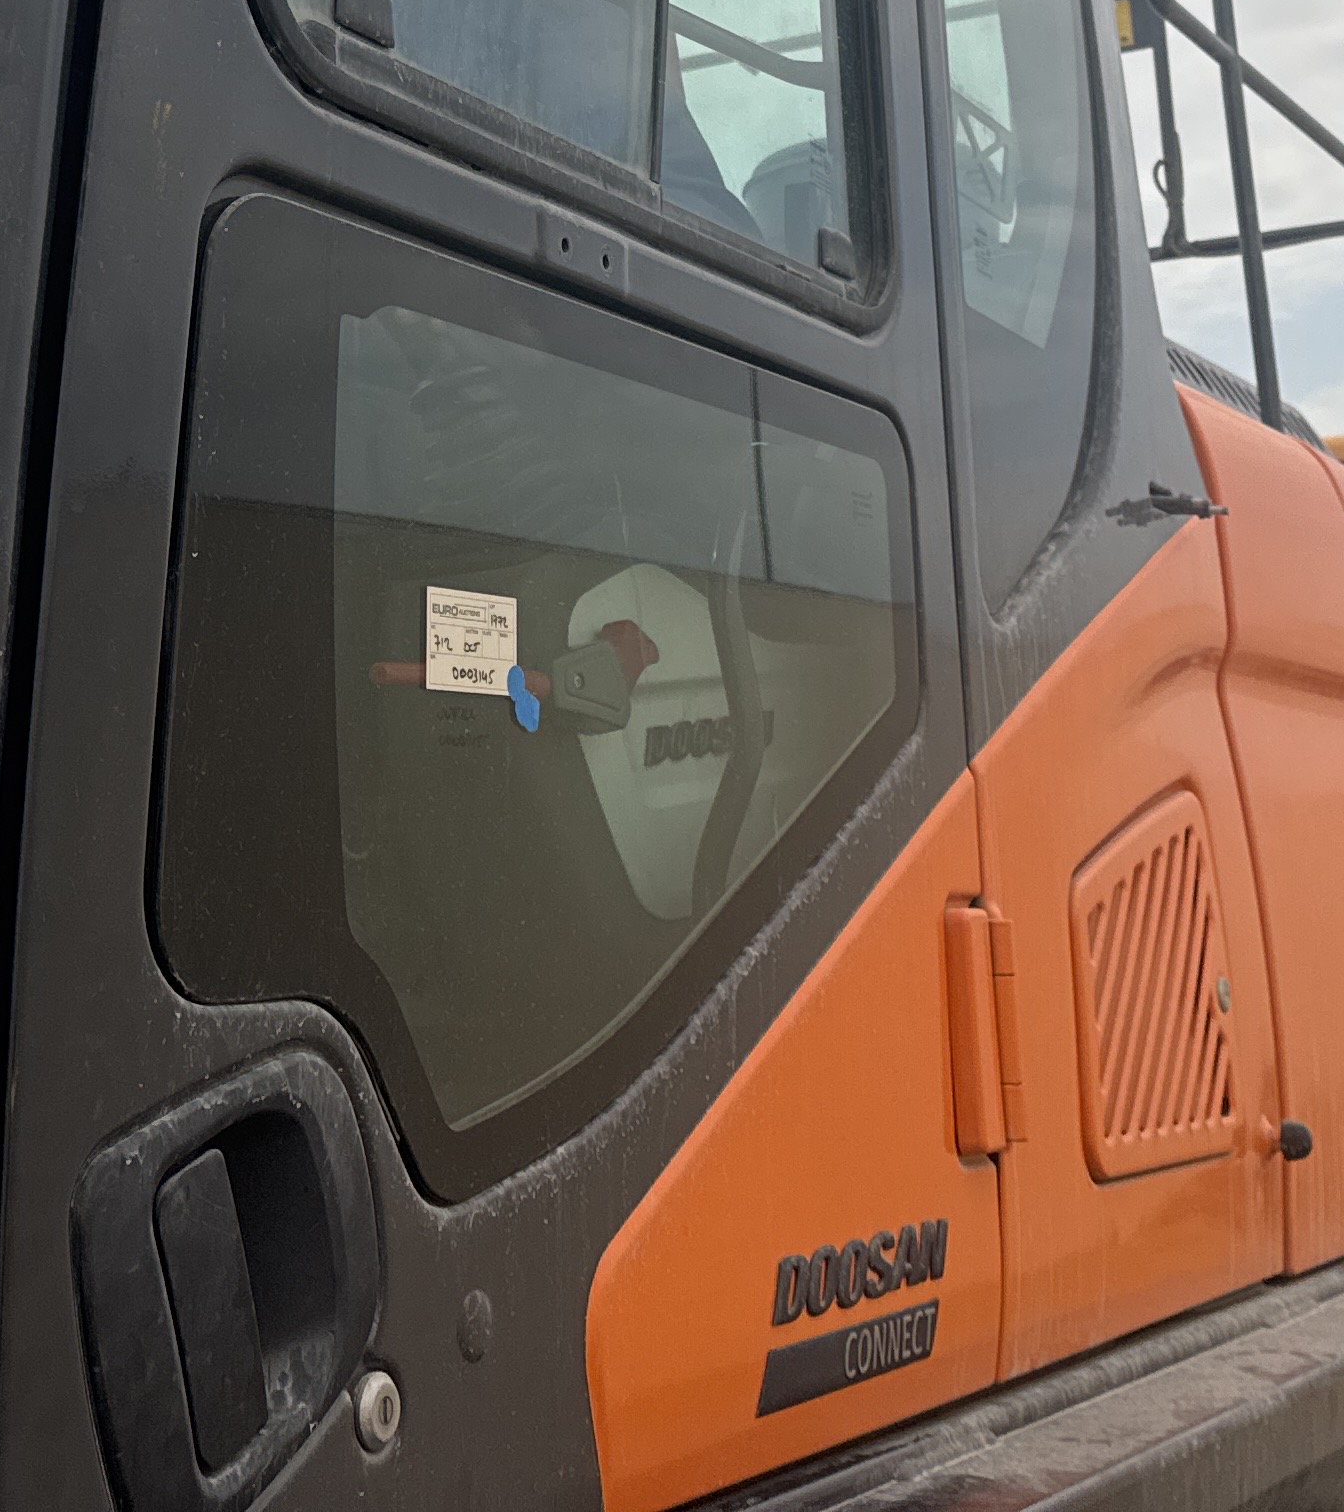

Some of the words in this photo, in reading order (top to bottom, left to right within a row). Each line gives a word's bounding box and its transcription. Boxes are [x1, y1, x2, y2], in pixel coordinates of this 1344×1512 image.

[431, 603, 458, 617] EURO
[434, 634, 454, 652] 712
[452, 666, 496, 685] 0003145
[771, 1218, 948, 1327] DOOSAN
[844, 1307, 936, 1379] CONNECT
